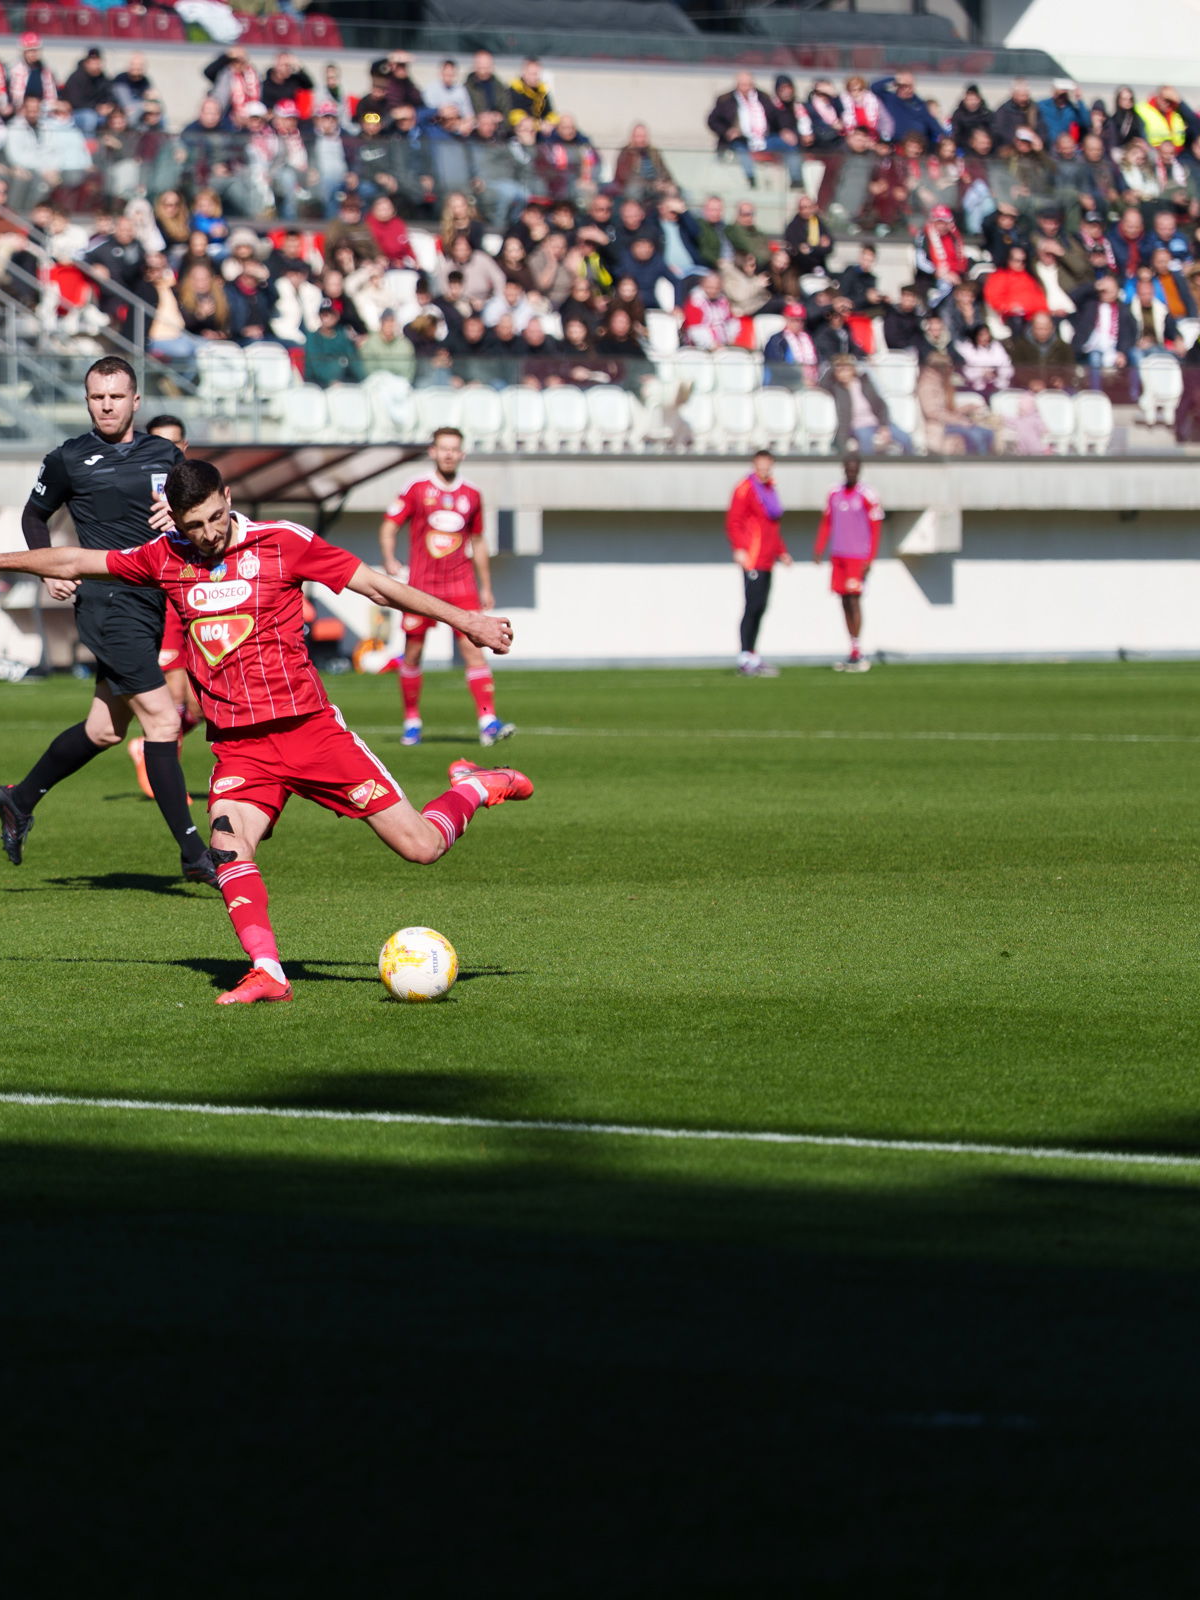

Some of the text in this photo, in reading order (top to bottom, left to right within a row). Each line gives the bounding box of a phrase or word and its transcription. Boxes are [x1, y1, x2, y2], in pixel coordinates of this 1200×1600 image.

[193, 586, 247, 602] DIÓSZEGI
[200, 623, 230, 642] MOL
[352, 786, 367, 801] MOL
